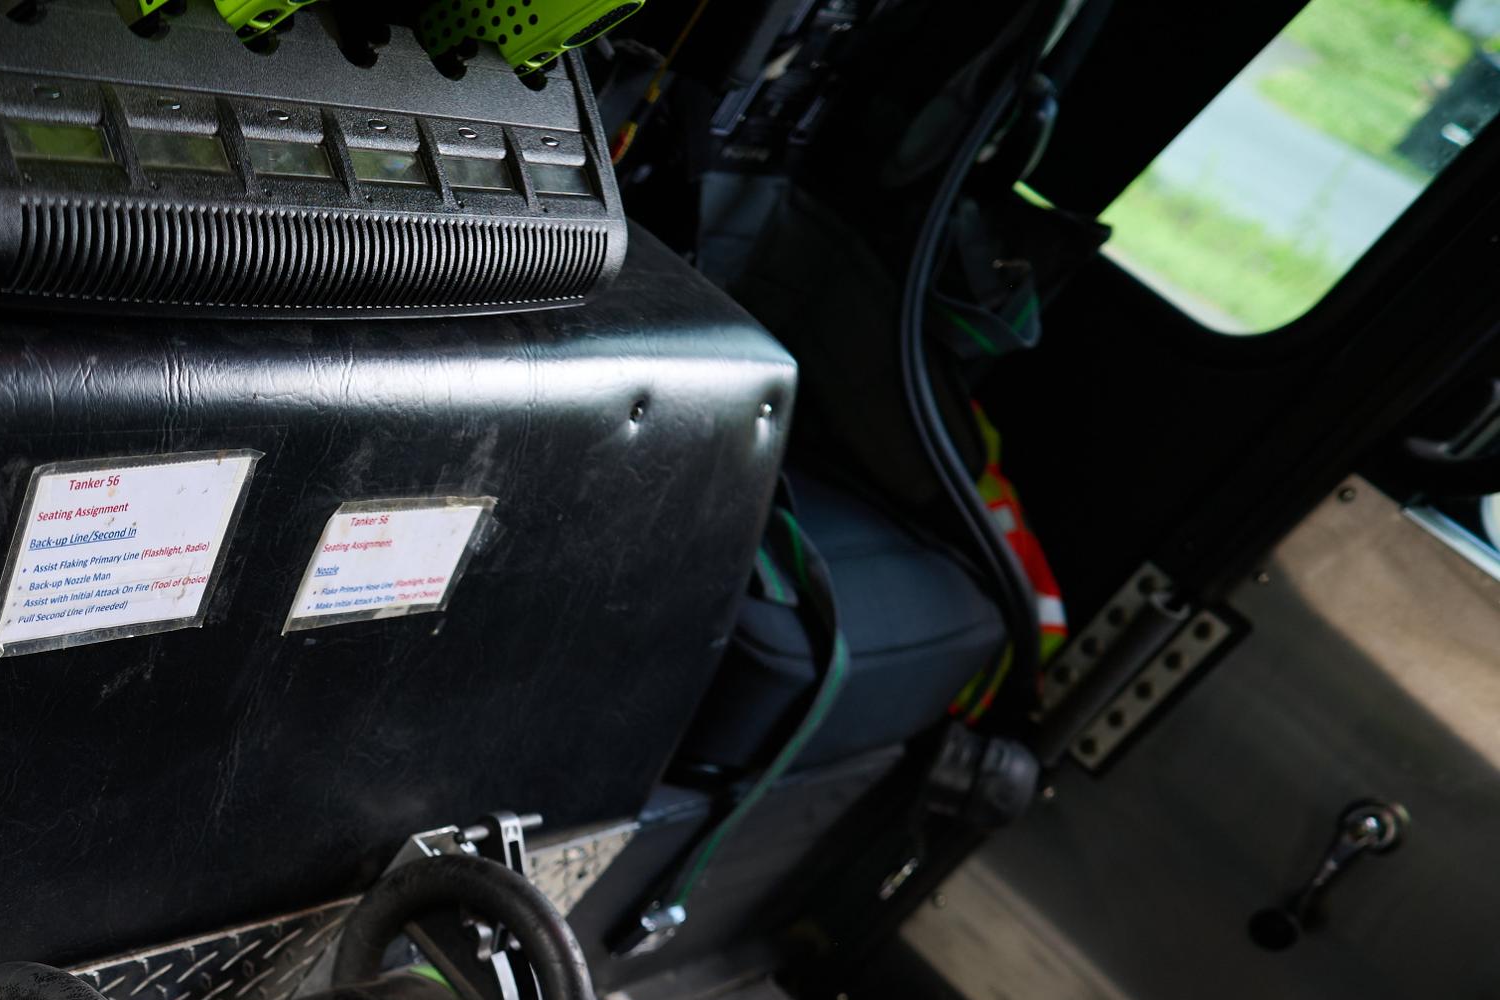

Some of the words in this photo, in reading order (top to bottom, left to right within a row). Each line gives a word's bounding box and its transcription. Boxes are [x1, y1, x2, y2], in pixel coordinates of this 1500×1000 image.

[69, 478, 105, 490] Tanker
[106, 475, 120, 486] 56
[37, 510, 73, 521] Seating
[75, 503, 129, 517] Assignment
[350, 517, 377, 527] Tanker
[29, 536, 68, 549] Back-up
[70, 527, 127, 543] Line/Second
[128, 527, 137, 537] In
[322, 542, 350, 553] Seating
[351, 539, 392, 551] Assignment
[33, 562, 57, 573] Assist
[60, 558, 88, 568] Flaking
[90, 554, 121, 565] Primary
[123, 552, 140, 561] Line
[141, 545, 183, 560] (Flashlight,
[185, 541, 210, 553] Radio)
[29, 580, 62, 591] Back-up
[64, 575, 91, 586] Nozzle
[93, 572, 111, 581] Man
[23, 598, 49, 608] Assist
[50, 594, 69, 604] with
[70, 590, 94, 601] Initial
[94, 588, 119, 598] Attack
[122, 585, 134, 594] On
[135, 583, 149, 593] Fire
[151, 579, 172, 592] (Tool
[173, 578, 181, 586] of
[18, 614, 35, 624] Pull
[36, 610, 65, 622] Second
[67, 607, 83, 617] Line
[85, 605, 95, 616] (if
[95, 600, 128, 613] needed)
